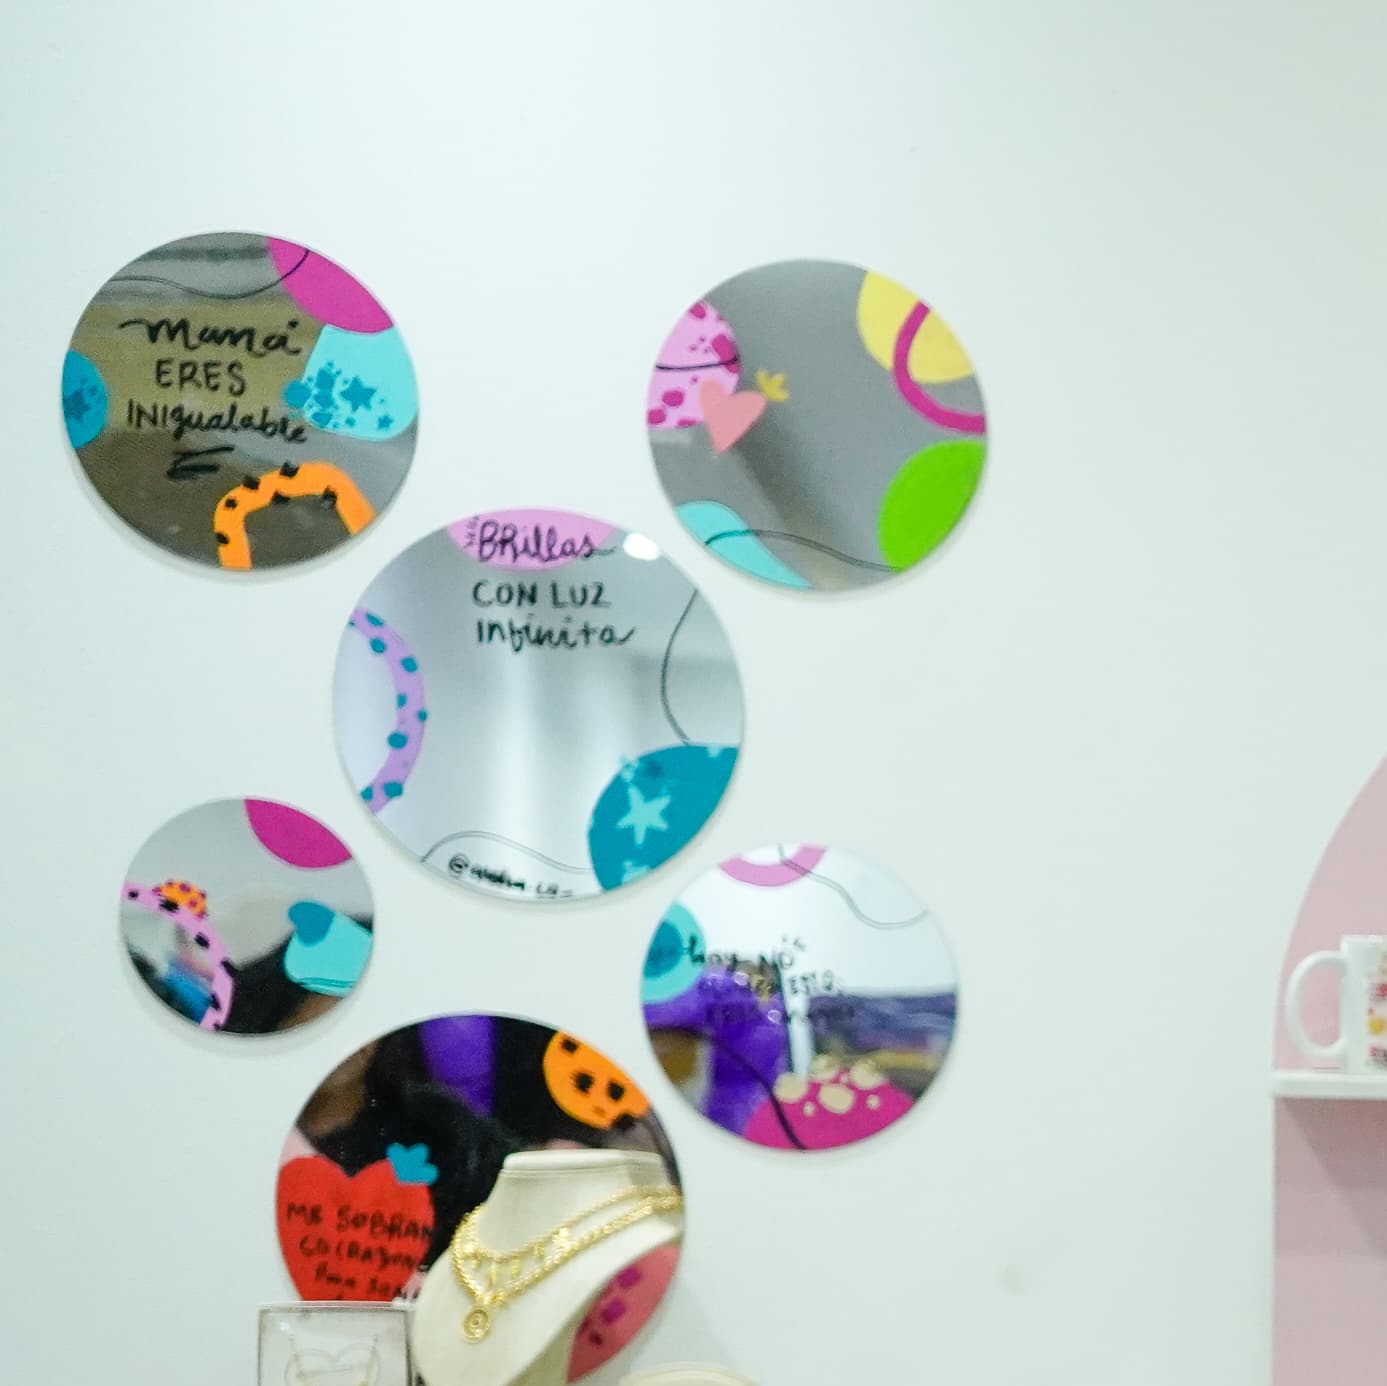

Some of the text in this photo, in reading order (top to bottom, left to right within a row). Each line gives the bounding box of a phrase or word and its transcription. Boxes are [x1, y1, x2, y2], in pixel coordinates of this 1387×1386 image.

[156, 358, 246, 396] ERES
[473, 579, 612, 608] CON LUZ
